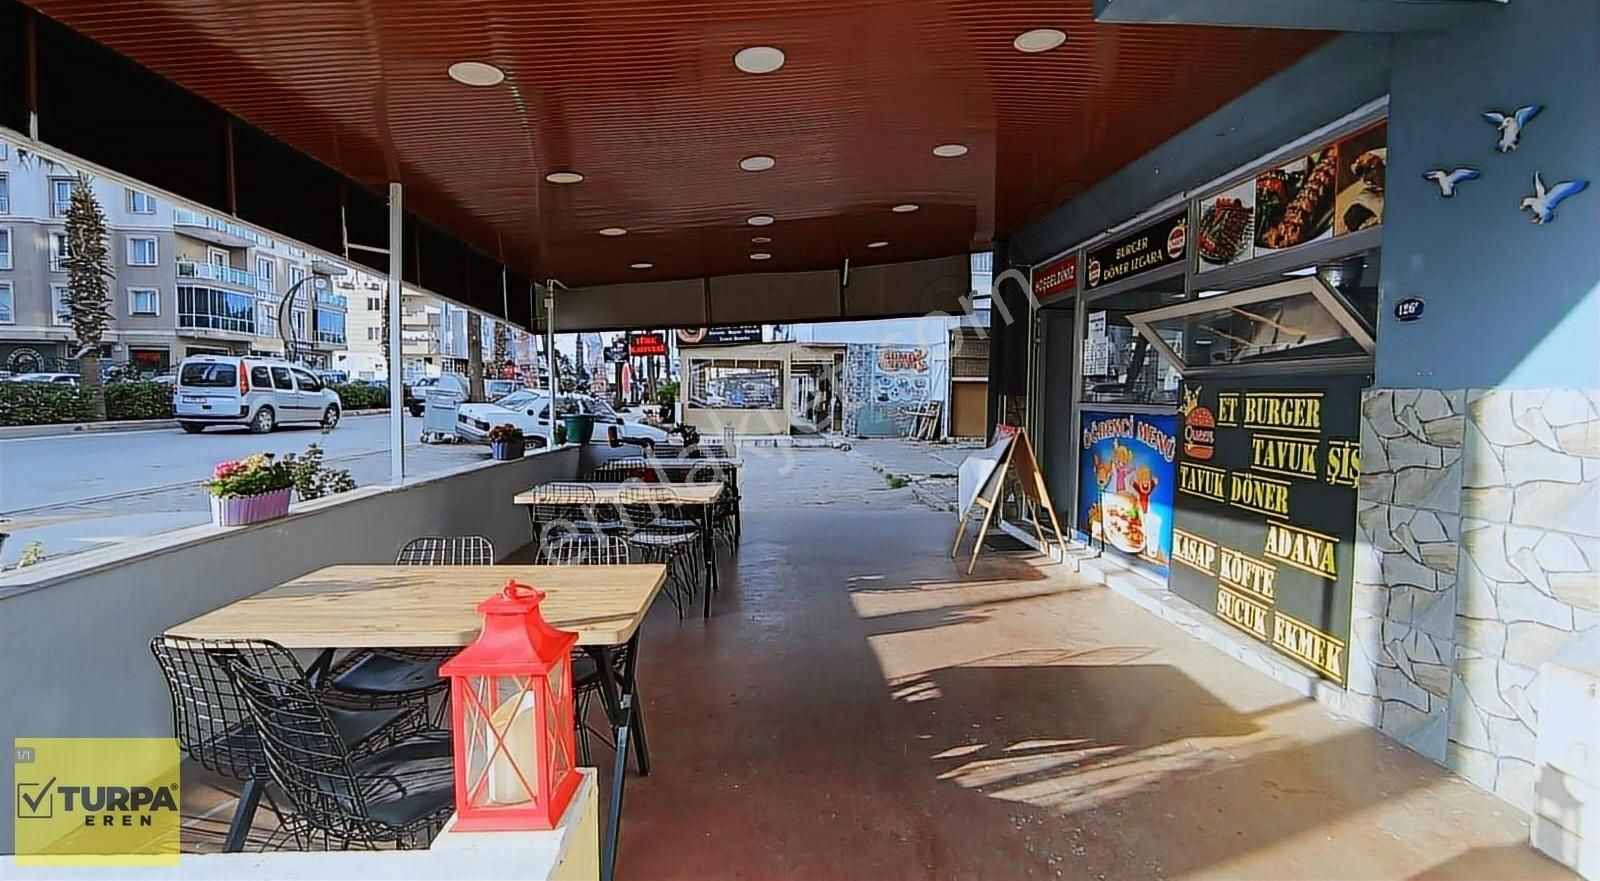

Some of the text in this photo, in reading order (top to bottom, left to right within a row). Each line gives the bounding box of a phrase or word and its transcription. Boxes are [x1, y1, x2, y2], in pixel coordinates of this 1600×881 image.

[1116, 237, 1148, 260] BURGER
[1218, 397, 1320, 428] ET BURGER
[1252, 437, 1318, 474] TAVUK
[1179, 464, 1289, 514] TAVUK DÖNER
[1171, 532, 1275, 599] KASAP KÖFTE
[1265, 525, 1335, 574] ADANA
[1217, 589, 1345, 678] SUCUK EKMEK
